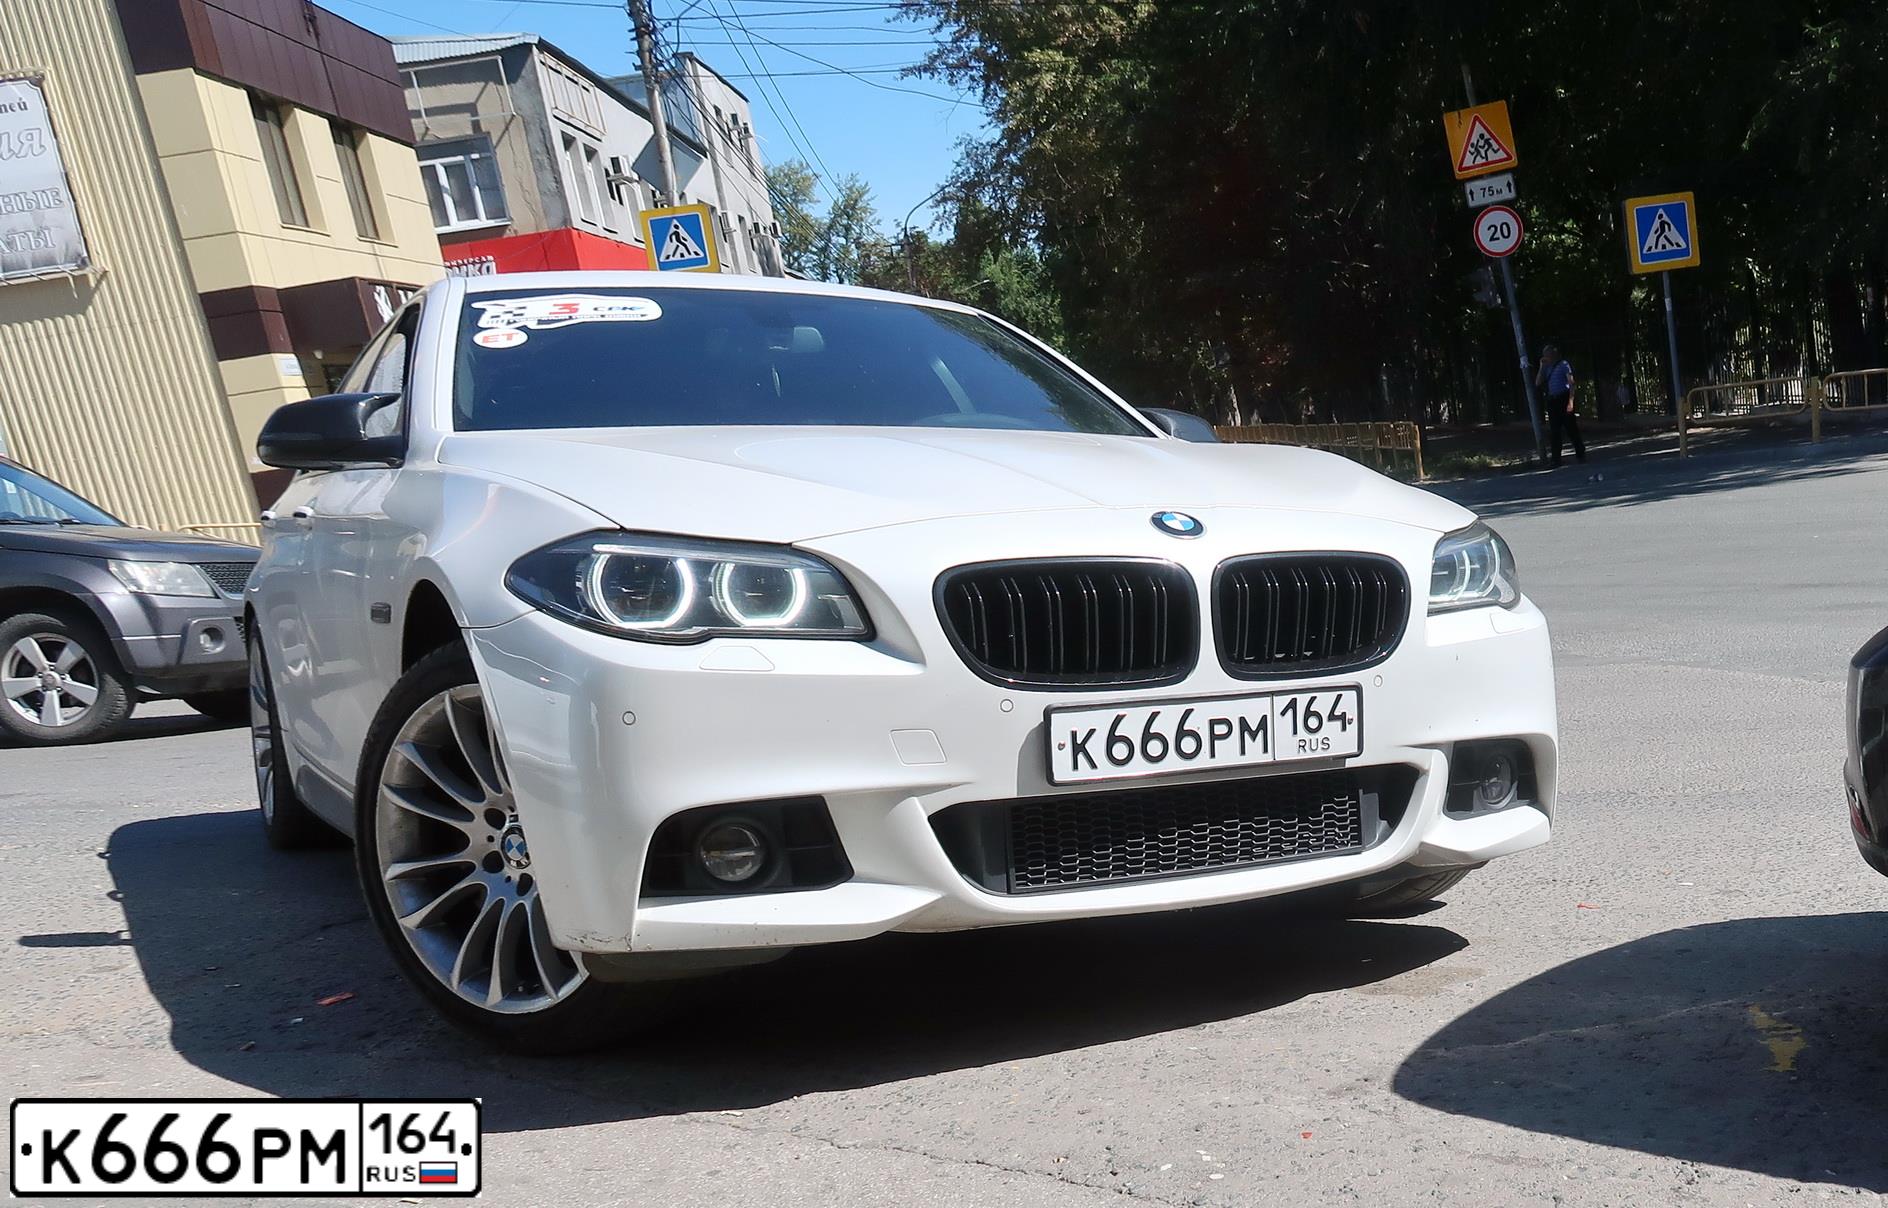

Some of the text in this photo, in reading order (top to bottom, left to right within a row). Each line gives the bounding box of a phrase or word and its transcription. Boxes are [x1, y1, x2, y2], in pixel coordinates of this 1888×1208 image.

[1487, 222, 1511, 242] 20
[1280, 694, 1347, 735] 164
[1298, 737, 1331, 753] RUS
